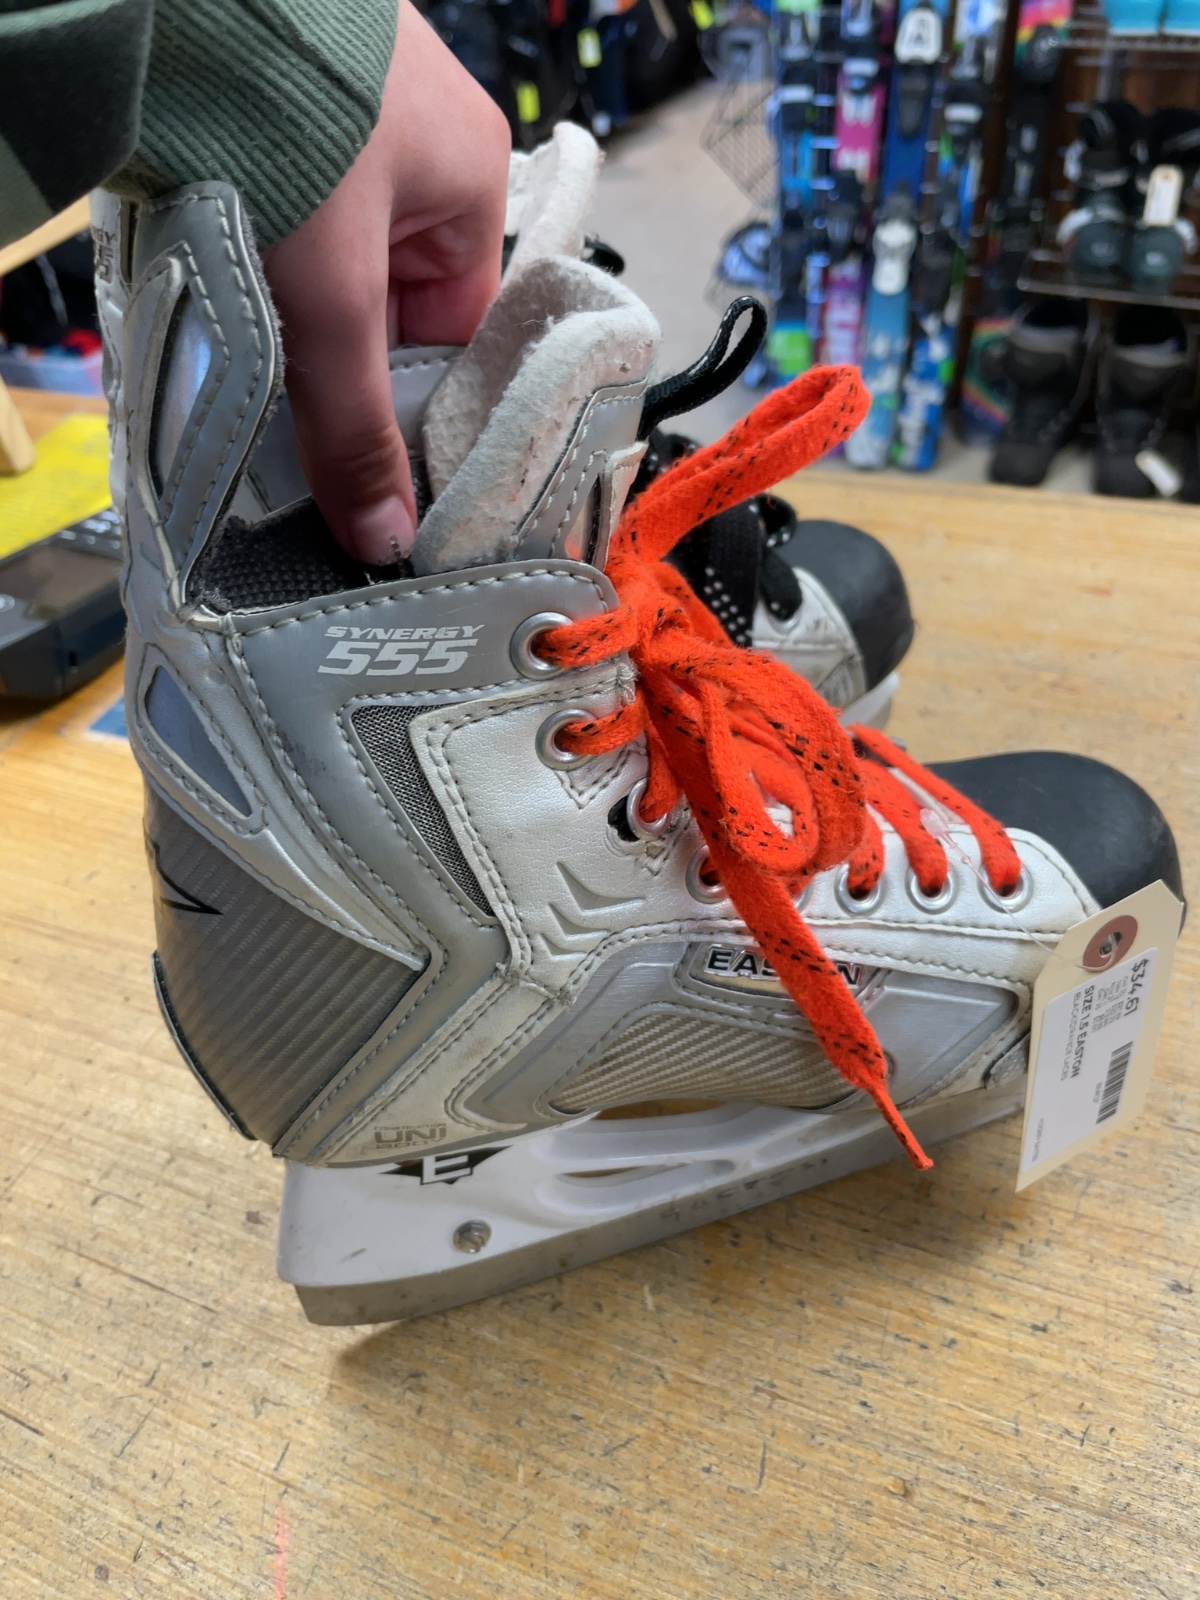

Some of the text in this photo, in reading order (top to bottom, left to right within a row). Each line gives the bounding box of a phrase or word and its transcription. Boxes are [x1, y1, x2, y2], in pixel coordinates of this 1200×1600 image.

[324, 624, 486, 640] SYNERGY
[317, 638, 479, 676] 555
[1123, 957, 1150, 1017] $34.61
[1070, 984, 1095, 1079] SIZE 1.5 EASTON
